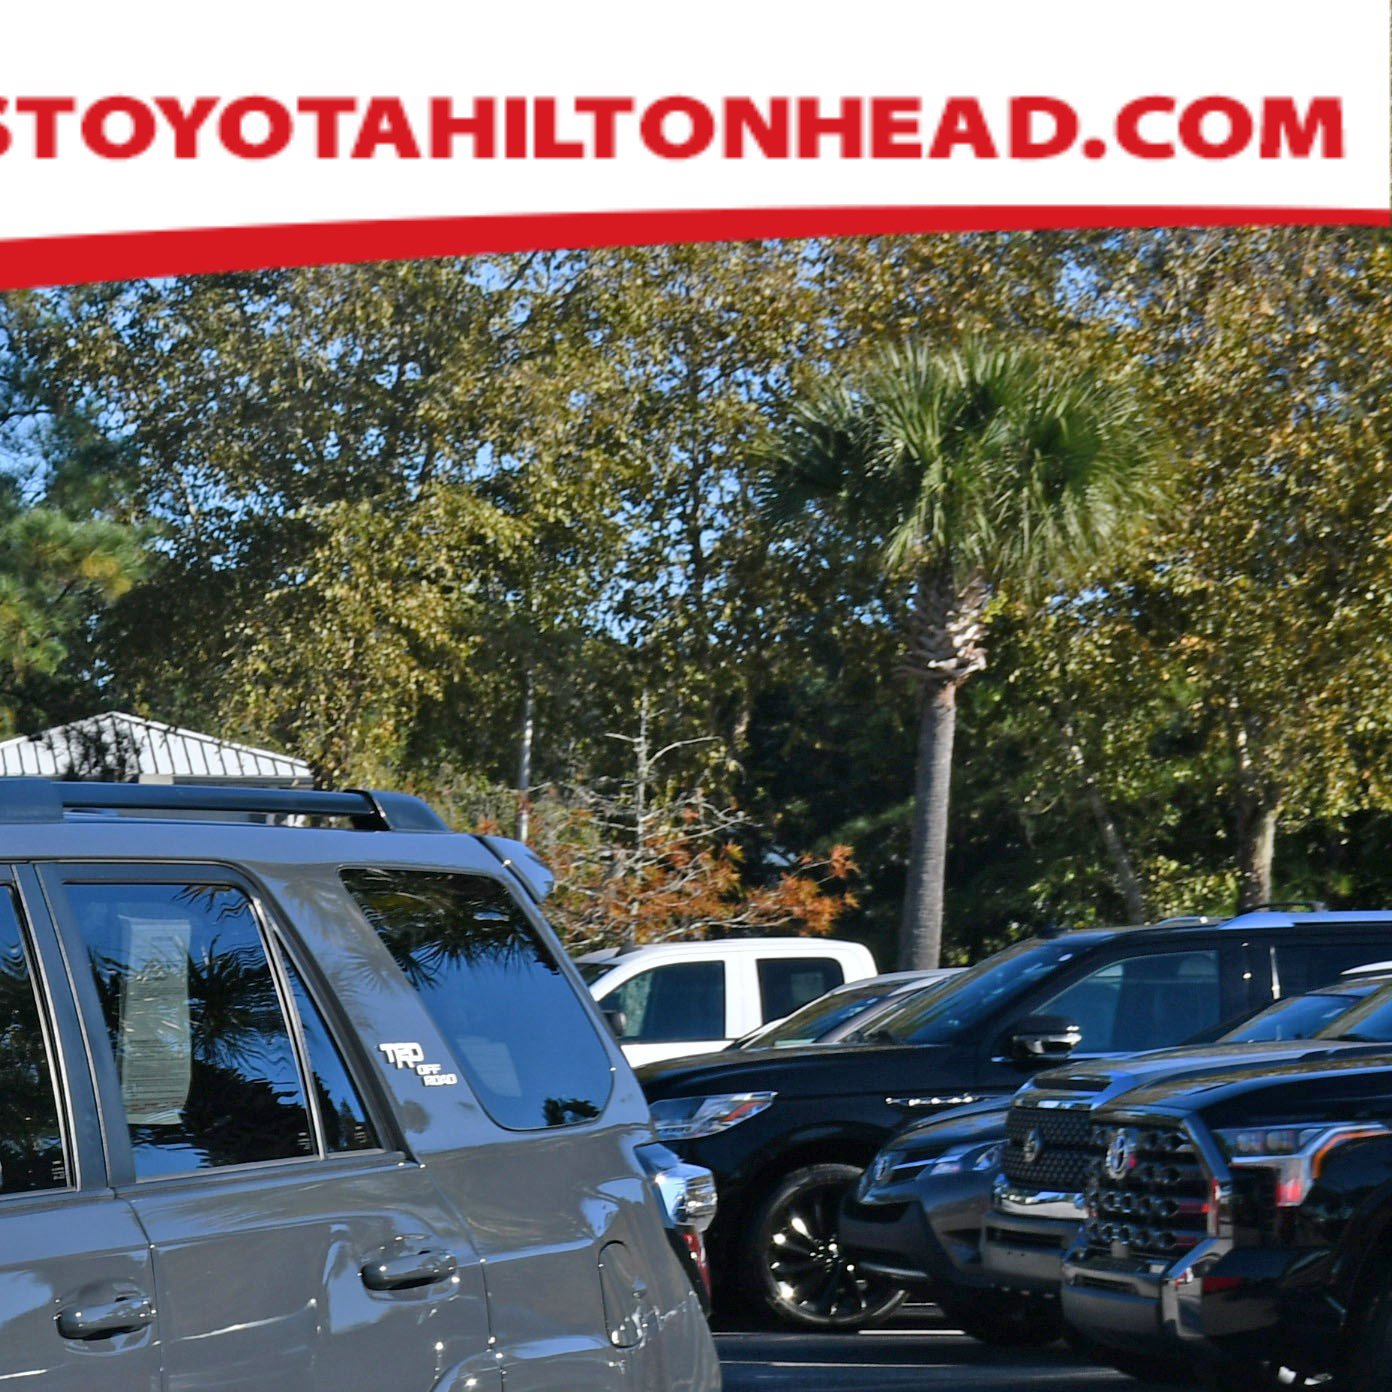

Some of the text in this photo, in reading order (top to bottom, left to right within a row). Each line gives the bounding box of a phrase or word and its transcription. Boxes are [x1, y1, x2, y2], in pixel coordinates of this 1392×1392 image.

[378, 1041, 424, 1069] TRD
[416, 1063, 442, 1076] OFF
[421, 1073, 459, 1087] ROAD
